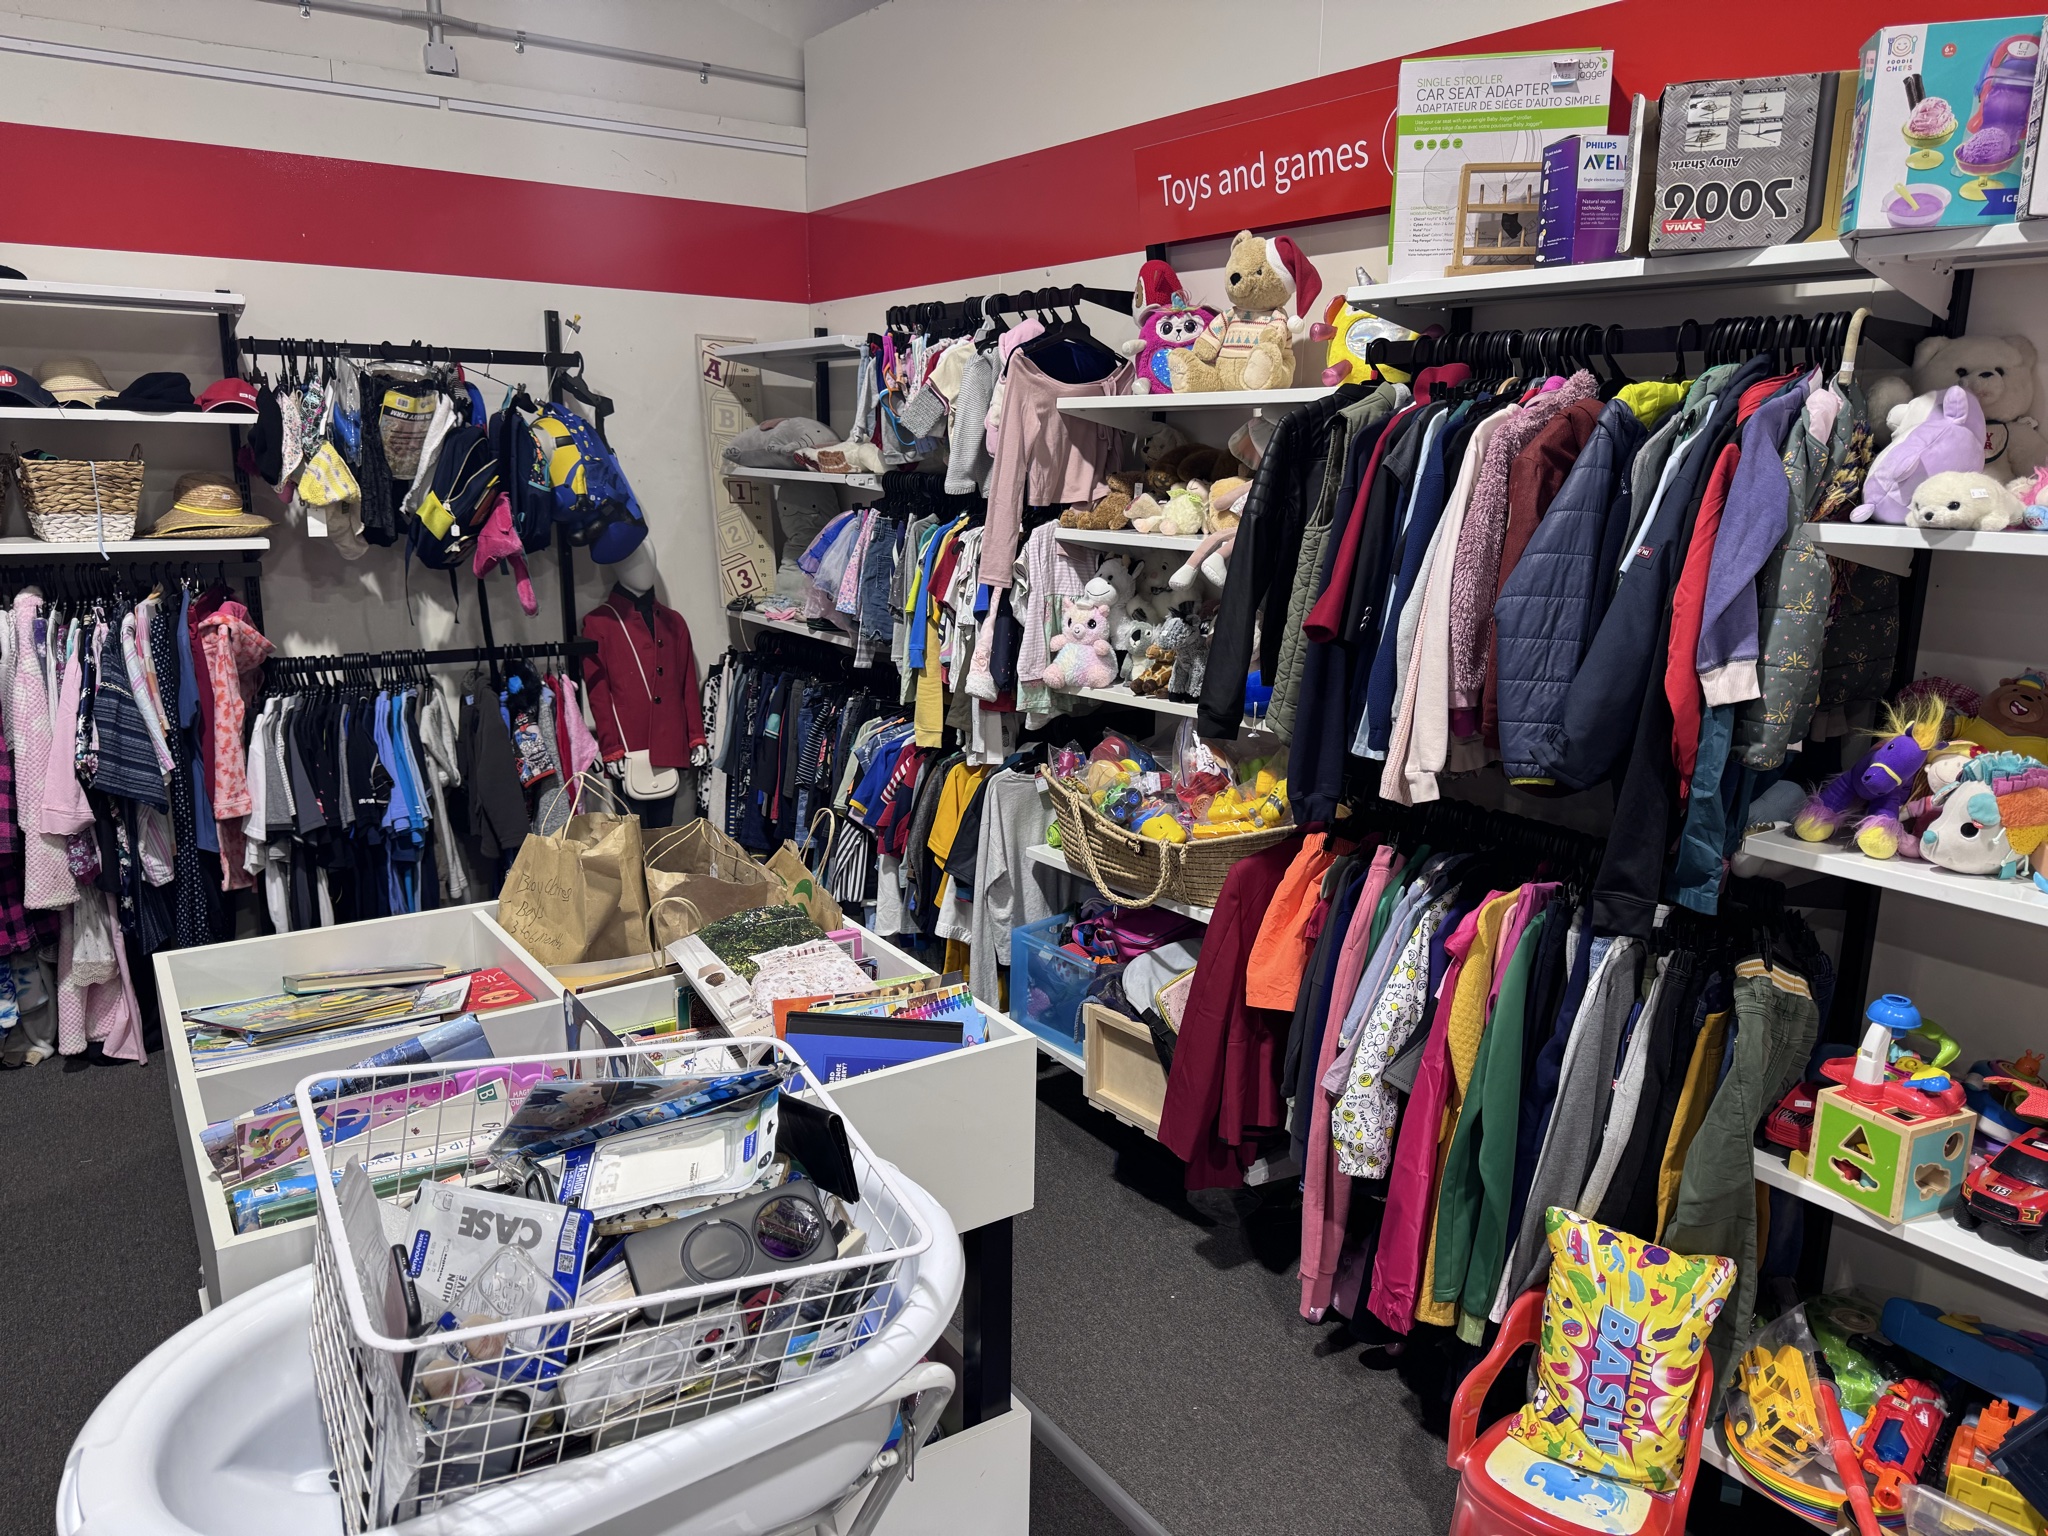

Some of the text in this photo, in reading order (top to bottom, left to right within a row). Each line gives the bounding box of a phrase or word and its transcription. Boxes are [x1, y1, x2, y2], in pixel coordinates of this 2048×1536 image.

[1578, 58, 1600, 71] baby
[1886, 64, 1912, 72] CHEFS
[1416, 74, 1503, 88] SINGLE STROLLER
[1576, 69, 1606, 80] jogger
[1416, 82, 1550, 102] CAR SEAT ADAPTER
[1416, 94, 1600, 114] ADAPTATEUR DE SIÈGE D'AUTO SIMPLE
[1586, 141, 1618, 149] PHILIPS
[1583, 154, 1627, 170] AVEN
[1670, 156, 1742, 170] Alloy Shark
[1158, 139, 1369, 211] Toys and games
[2002, 194, 2018, 203] ICE
[704, 358, 722, 381] A
[719, 408, 735, 428] B
[736, 484, 746, 500] 1
[727, 526, 742, 544] 2
[736, 568, 752, 588] 3
[516, 901, 545, 926] Boys
[511, 920, 518, 934] 3
[480, 1088, 494, 1100] B
[362, 1152, 418, 1172] Encycl
[573, 1162, 588, 1196] FASHION
[458, 1206, 542, 1250] CASE
[442, 1273, 456, 1303] HION
[1622, 1342, 1657, 1443] PILLOW
